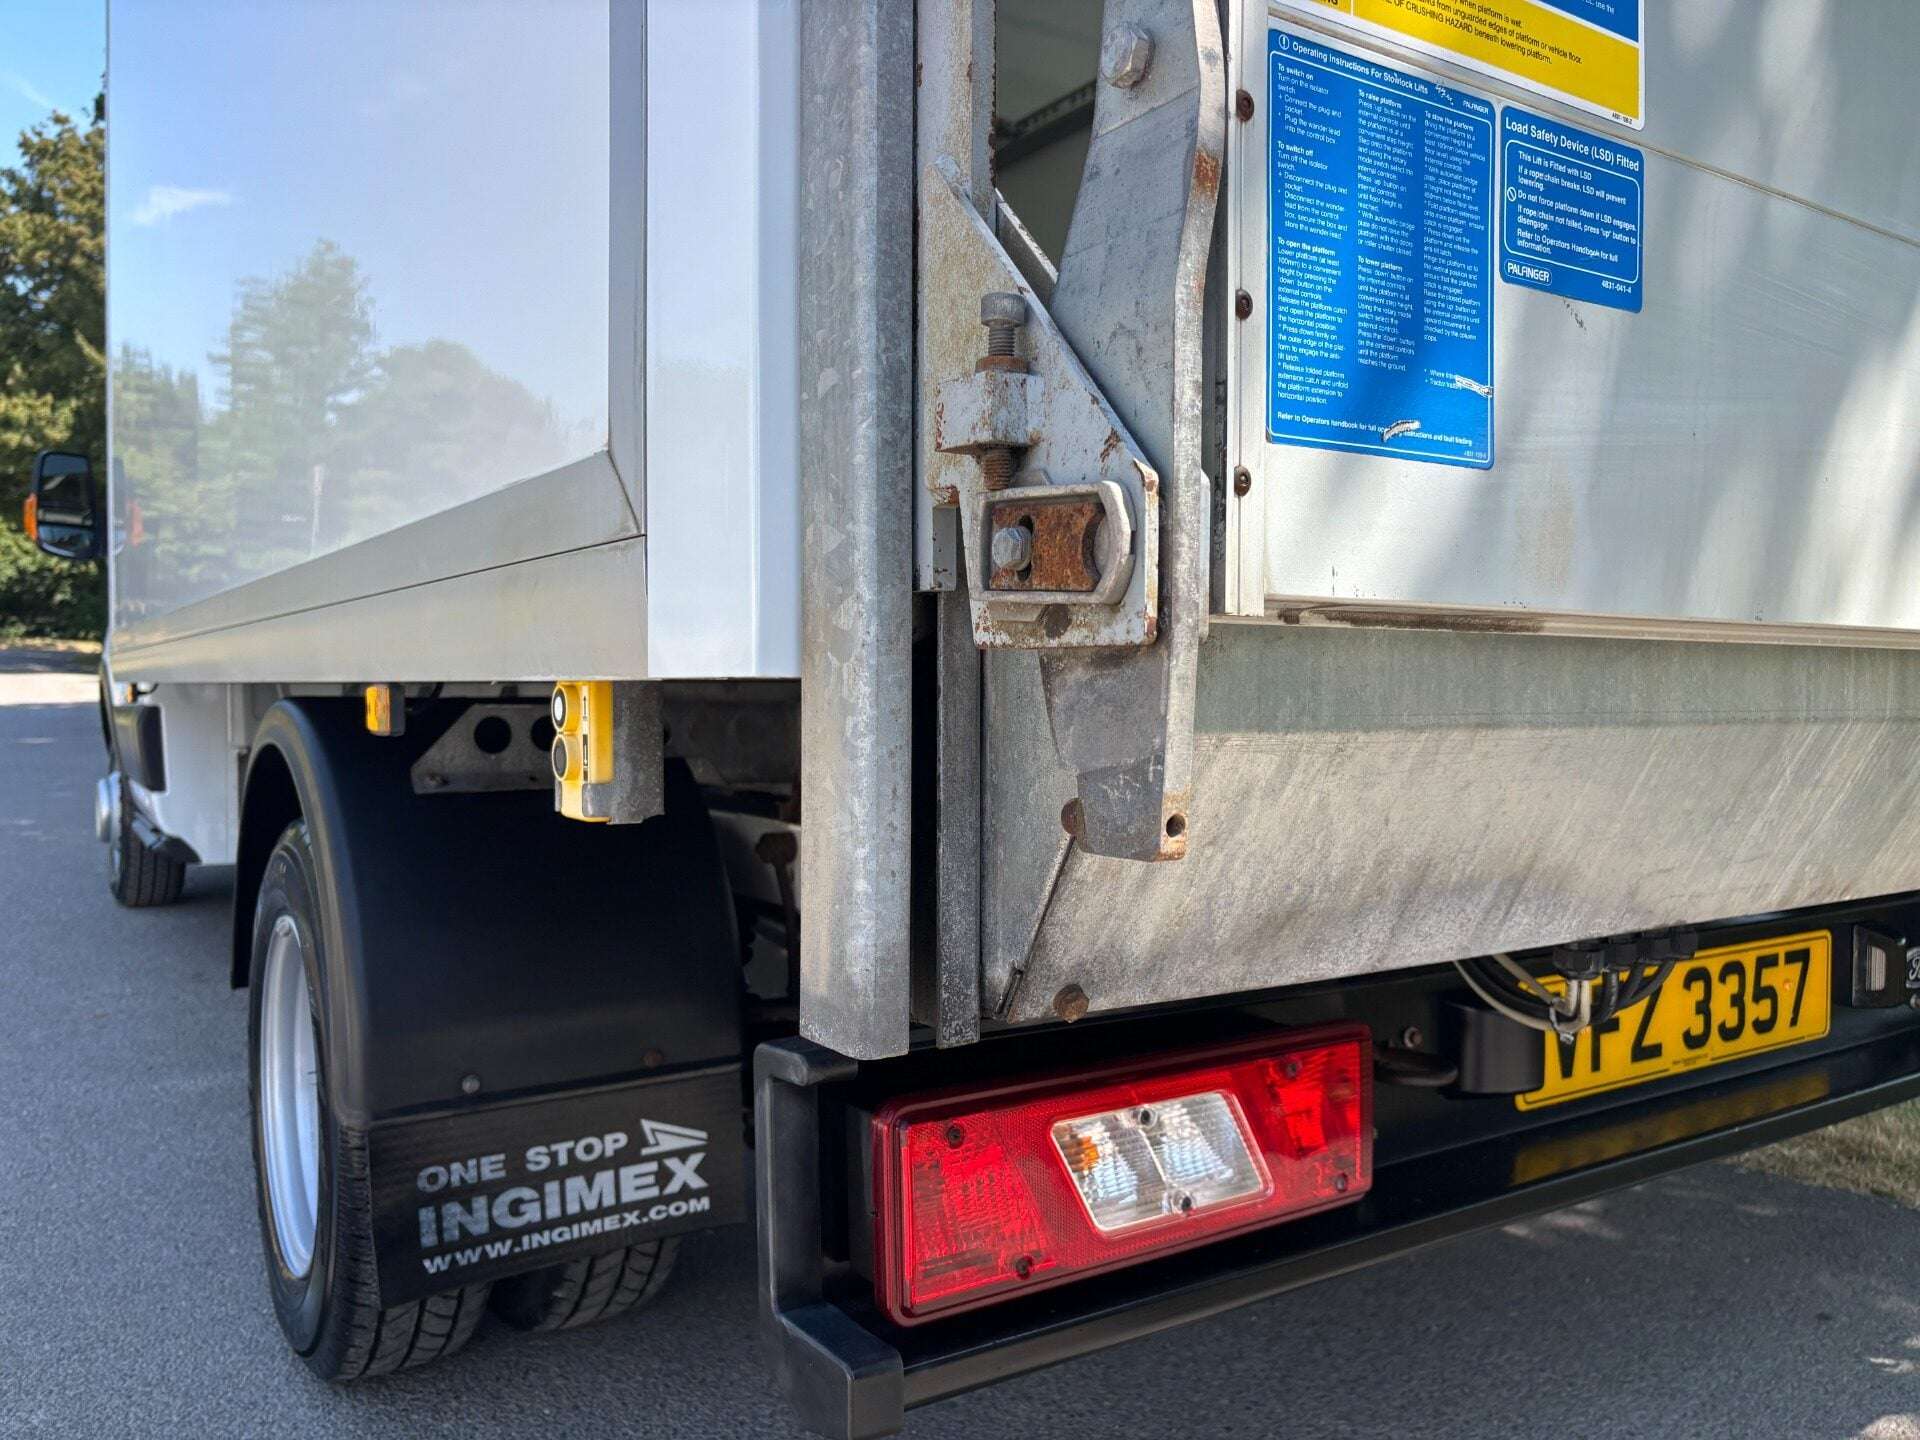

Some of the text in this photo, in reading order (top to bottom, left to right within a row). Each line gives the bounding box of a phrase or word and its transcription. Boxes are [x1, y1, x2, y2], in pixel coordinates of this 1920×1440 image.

[1406, 1, 1444, 22] CRUSHING
[1445, 16, 1473, 33] HAZARD
[1474, 24, 1499, 43] beneath
[1500, 36, 1526, 56] lowering
[1437, 1, 1452, 13] from
[1453, 7, 1487, 27] unguarded
[1488, 21, 1507, 36] edges
[1508, 26, 1515, 37] of
[1516, 29, 1540, 48] platform
[1540, 42, 1547, 50] or
[1548, 43, 1567, 59] vehicle
[1478, 4, 1503, 22] platform
[1278, 63, 1284, 71] To
[1286, 65, 1304, 78] switch
[1292, 43, 1328, 62] Operating
[1329, 53, 1369, 75] Instructions
[1371, 67, 1382, 80] For
[1414, 81, 1428, 95] Lifts
[1380, 95, 1401, 110] platform
[1278, 140, 1313, 157] To switch off
[1506, 117, 1639, 171] Load Safety Device (LSD) Fitted
[1518, 150, 1592, 181] This Lift is Fitted with LSD
[1518, 165, 1523, 173] If
[1582, 185, 1595, 195] LSD
[1595, 189, 1605, 198] will
[1606, 192, 1626, 206] prevent
[1518, 190, 1527, 199] Do
[1527, 193, 1538, 203] not
[1539, 195, 1553, 207] force
[1554, 200, 1579, 216] platform
[1579, 208, 1595, 219] down
[1600, 214, 1612, 224] LSD
[1518, 205, 1524, 213] If
[1555, 216, 1565, 225] not
[1583, 224, 1600, 236] press
[1612, 231, 1630, 242] button
[1630, 236, 1636, 244] to
[1278, 237, 1335, 258] To open the platform
[1296, 250, 1317, 264] platform
[1517, 228, 1618, 262] Refer to Operators Handbook for full
[1358, 255, 1364, 263] To
[1380, 261, 1402, 273] platform
[1507, 261, 1550, 283] PALFINGER
[1277, 411, 1294, 420] Refer
[1301, 414, 1329, 426] Operators
[1331, 418, 1357, 429] handbook
[1682, 947, 1811, 1050] 3357
[417, 1132, 628, 1193] ONE STOP
[418, 1152, 709, 1250] INGIMEX
[423, 1196, 710, 1275] WWW.INGIMEX.COM
